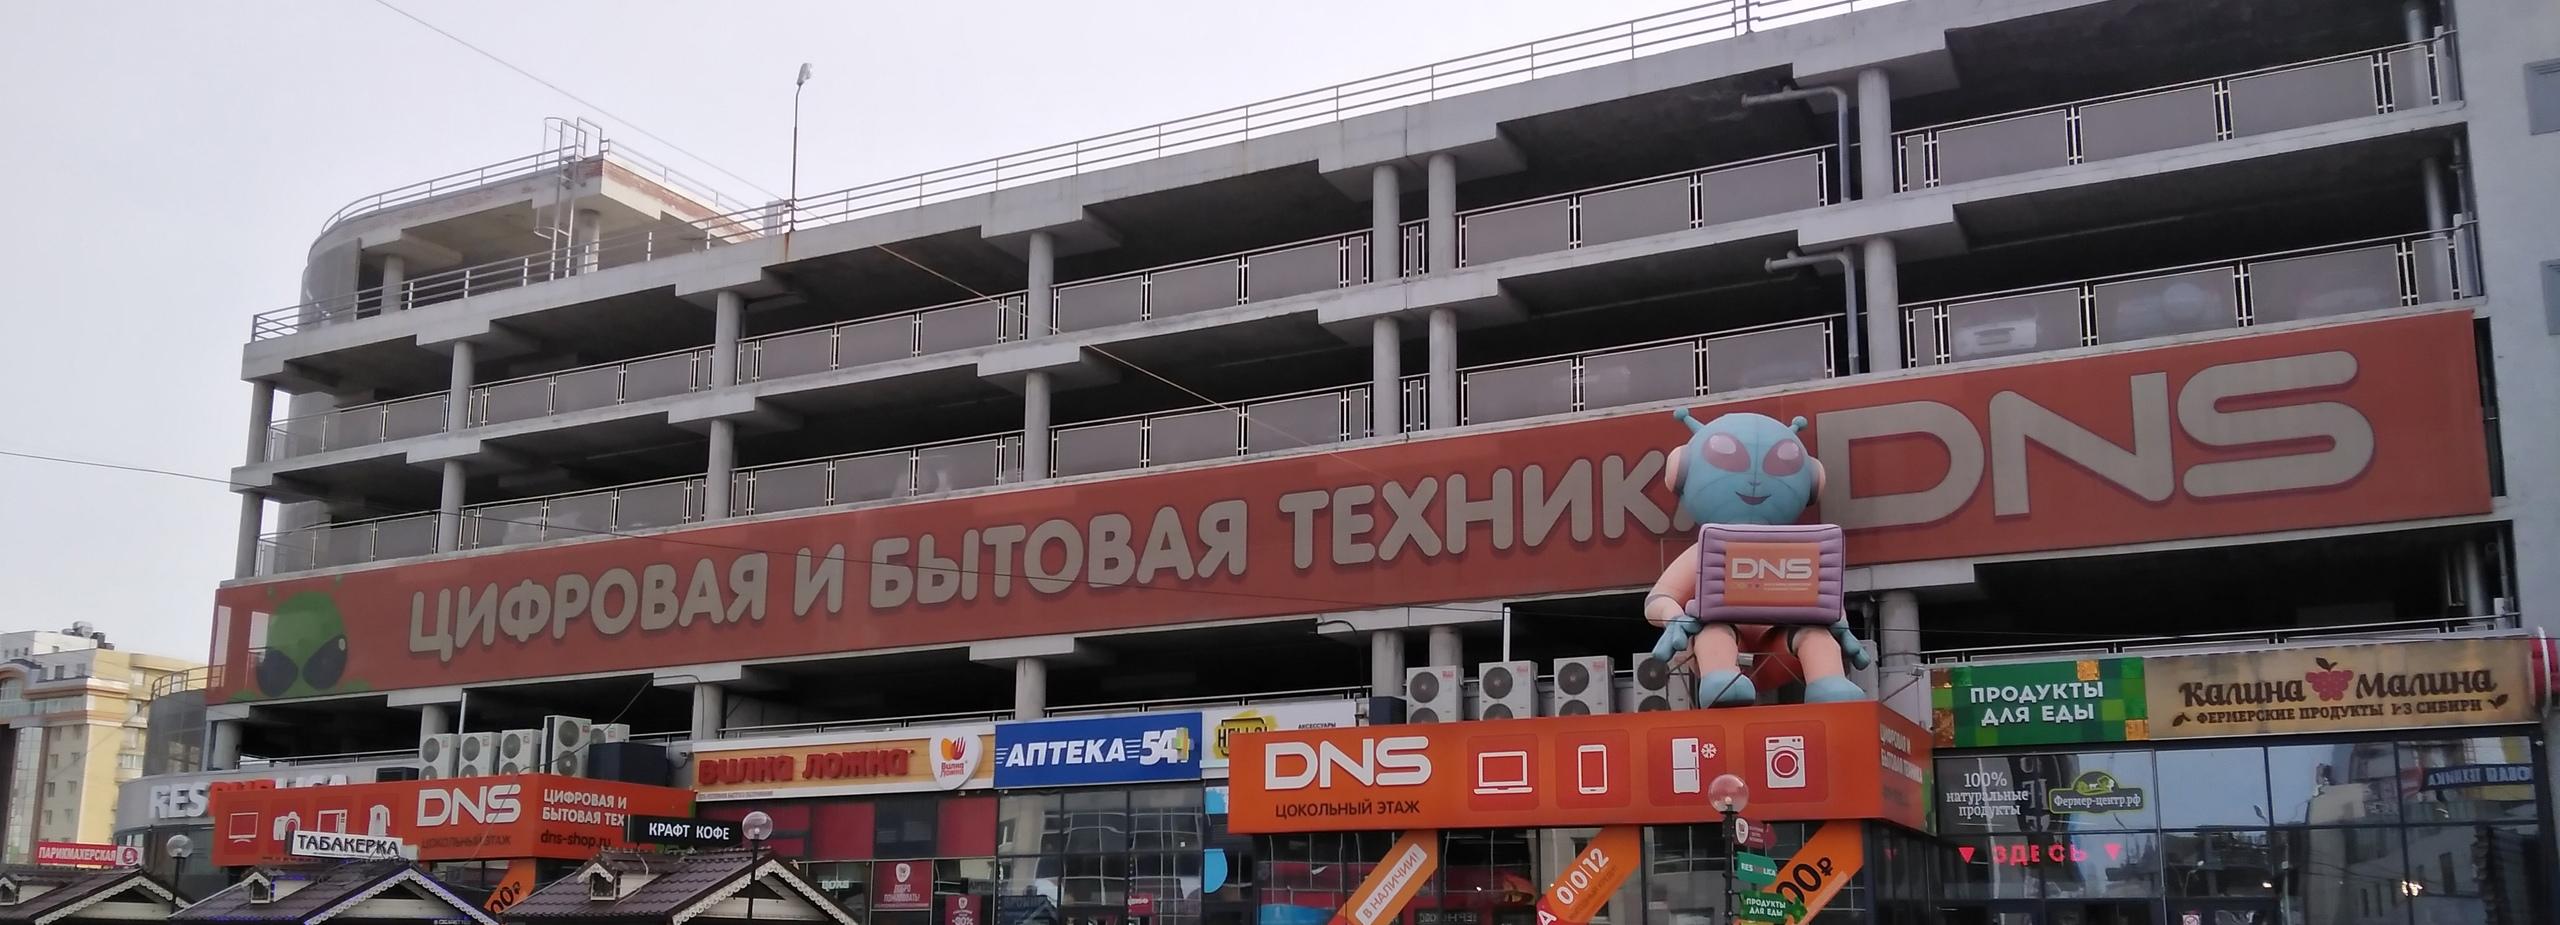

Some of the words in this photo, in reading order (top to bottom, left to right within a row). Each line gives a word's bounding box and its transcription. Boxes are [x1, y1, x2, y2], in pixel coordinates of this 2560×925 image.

[1816, 350, 2376, 530] DNS
[409, 552, 768, 663] ЦИФРОВАЯ
[794, 543, 846, 617] И
[869, 500, 1249, 609] БЫТОВАЯ
[1279, 449, 1695, 569] ТЕХНИК
[1731, 558, 1813, 579] DNS
[1970, 681, 2104, 703] ПРОДУКТЫ
[2178, 678, 2306, 707] Калина
[2355, 669, 2498, 699] Малина
[1981, 706, 2030, 726] ДЛЯ
[2042, 703, 2094, 723] ЕДЫ
[2197, 707, 2296, 724] ФЕРМЕРСКИЕ
[2300, 703, 2383, 721] ПРОДУКТЫ
[2416, 698, 2483, 714] СИБИРИ
[1005, 738, 1126, 767] АПТЕКА
[1265, 736, 1432, 790] DNS
[1964, 772, 2007, 787] 100%
[416, 783, 521, 827] DNS
[543, 788, 614, 808] ЦИФРОВАЯ
[617, 796, 627, 810] И
[1275, 799, 1373, 819] ЦОКОЛЬНЫЙ
[1377, 800, 1420, 815] ЭТАЖ
[1946, 790, 2029, 806] натуральные
[2054, 794, 2141, 808] Фермер-центр.рф
[542, 806, 601, 825] БЫТОВАЯ
[604, 812, 625, 827] ТЕХ
[1958, 804, 2021, 819] продукты
[540, 829, 612, 849] dns-shop.ru
[648, 822, 690, 838] КРАФТ
[696, 826, 730, 840] КОФЕ
[38, 846, 116, 862] ПАРИКМАХЕРСКАЯ
[297, 833, 399, 855] ТАБАКЕРКА
[1992, 843, 2088, 865] ЗДЕСЬ
[1362, 908, 1373, 919] В
[1372, 852, 1418, 912] НАЛИЧИИ!
[1746, 897, 1786, 909] ПРОДУКТЫ
[1749, 906, 1765, 915] ДЛЯ
[1767, 907, 1783, 917] ЕДЫ
